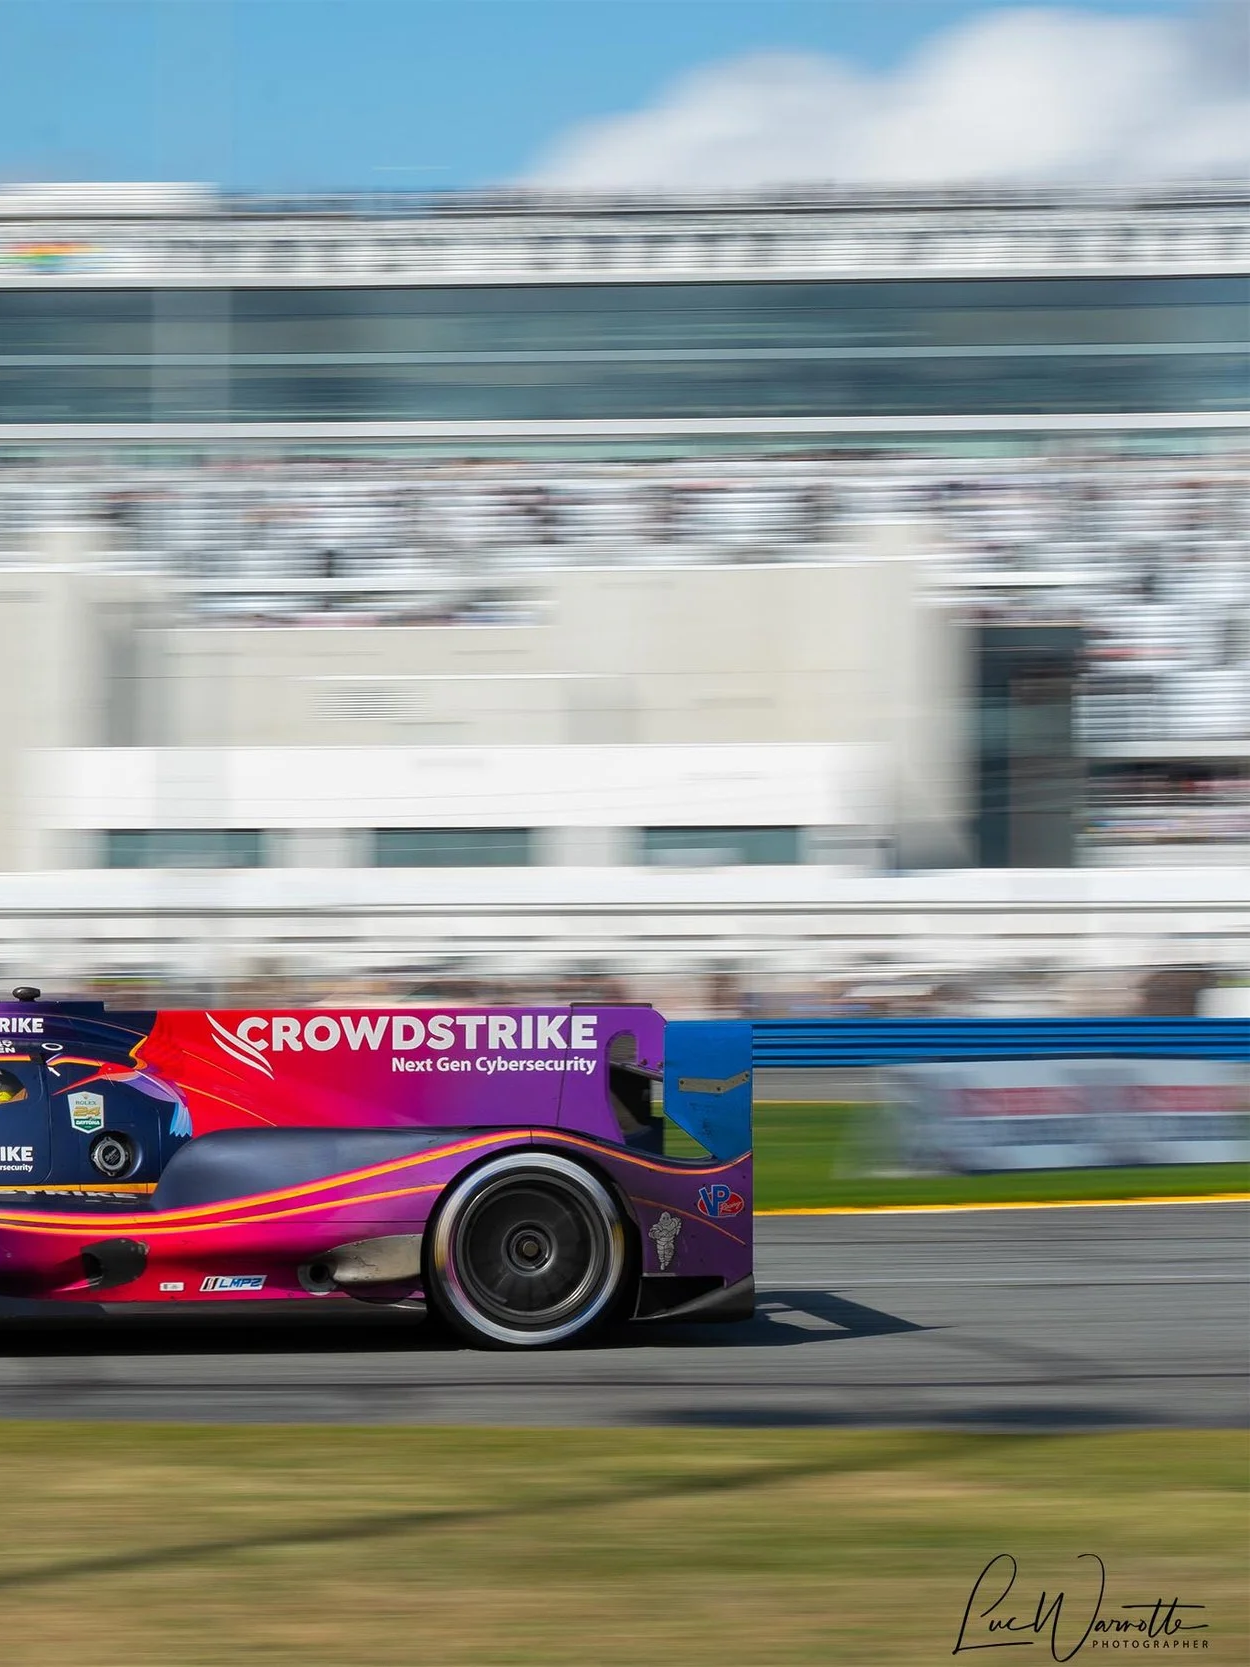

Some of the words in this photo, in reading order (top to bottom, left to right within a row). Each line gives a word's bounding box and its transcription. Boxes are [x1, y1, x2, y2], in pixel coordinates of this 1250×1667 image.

[237, 1015, 598, 1051] CROWDSTRIKE
[391, 1057, 433, 1072] Next
[437, 1057, 471, 1072] Gen
[475, 1056, 597, 1075] Cybersecurity
[699, 1184, 731, 1217] VP
[218, 1277, 263, 1288] LMP2
